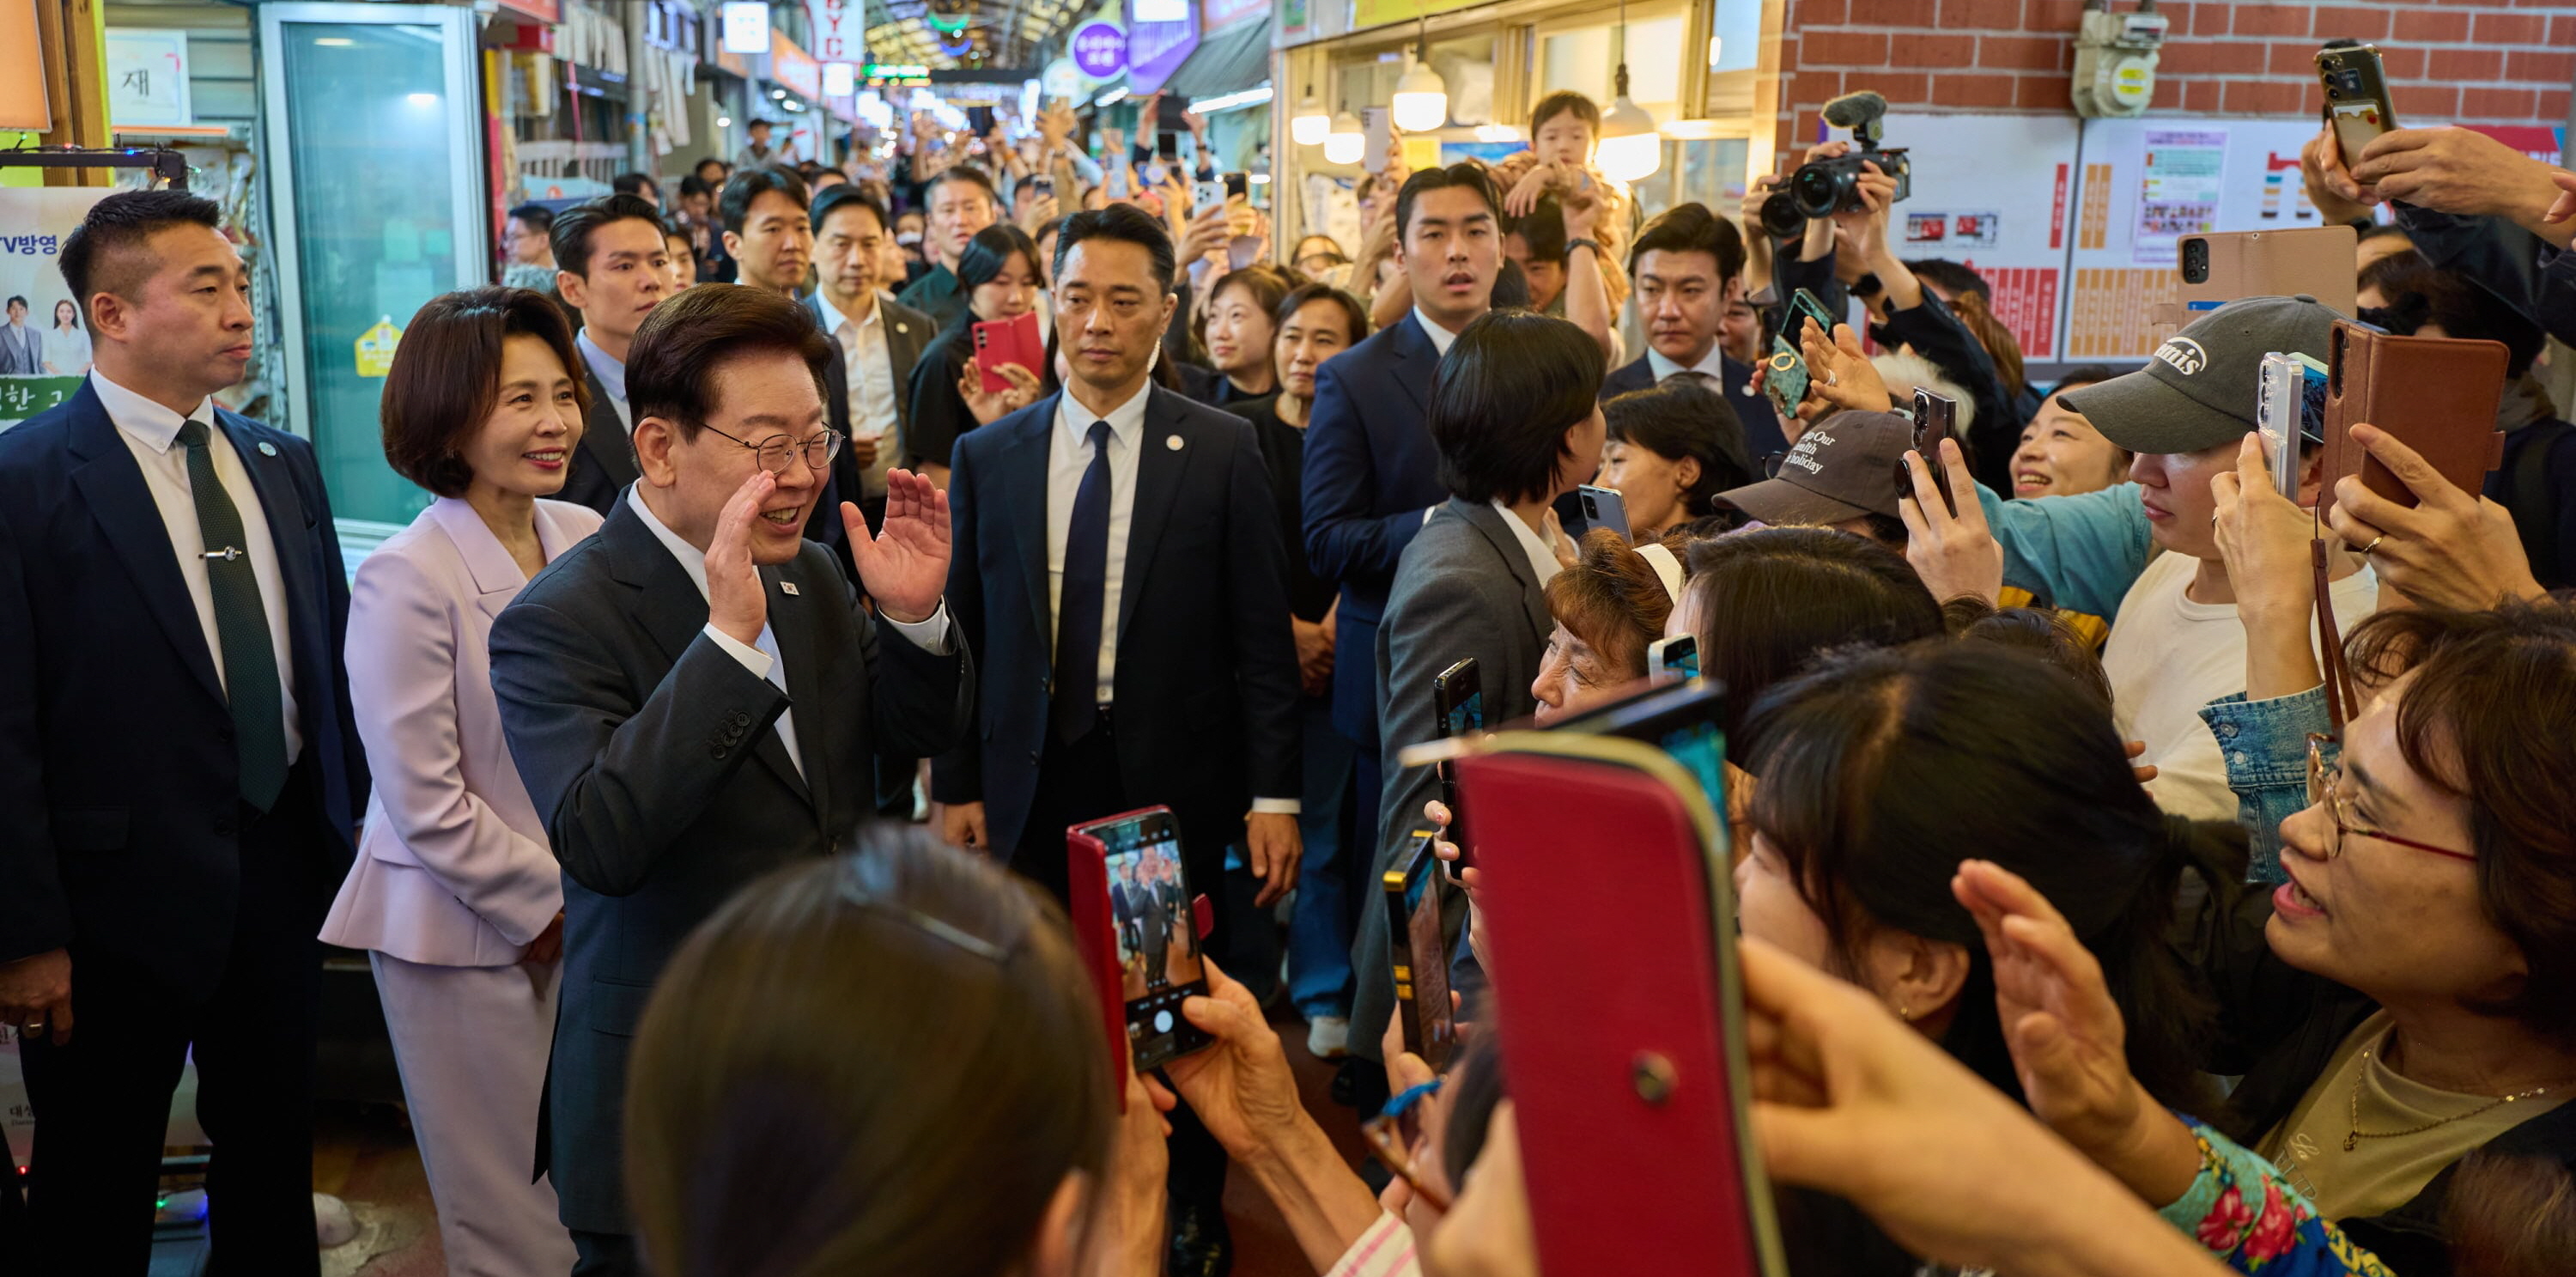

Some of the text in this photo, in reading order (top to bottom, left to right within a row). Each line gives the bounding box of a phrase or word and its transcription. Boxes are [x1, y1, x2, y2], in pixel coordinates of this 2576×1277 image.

[0, 234, 58, 255] V방영
[2154, 343, 2200, 375] mis
[0, 384, 36, 411] 한
[1814, 431, 1836, 446] Our
[1789, 452, 1824, 475] holiday
